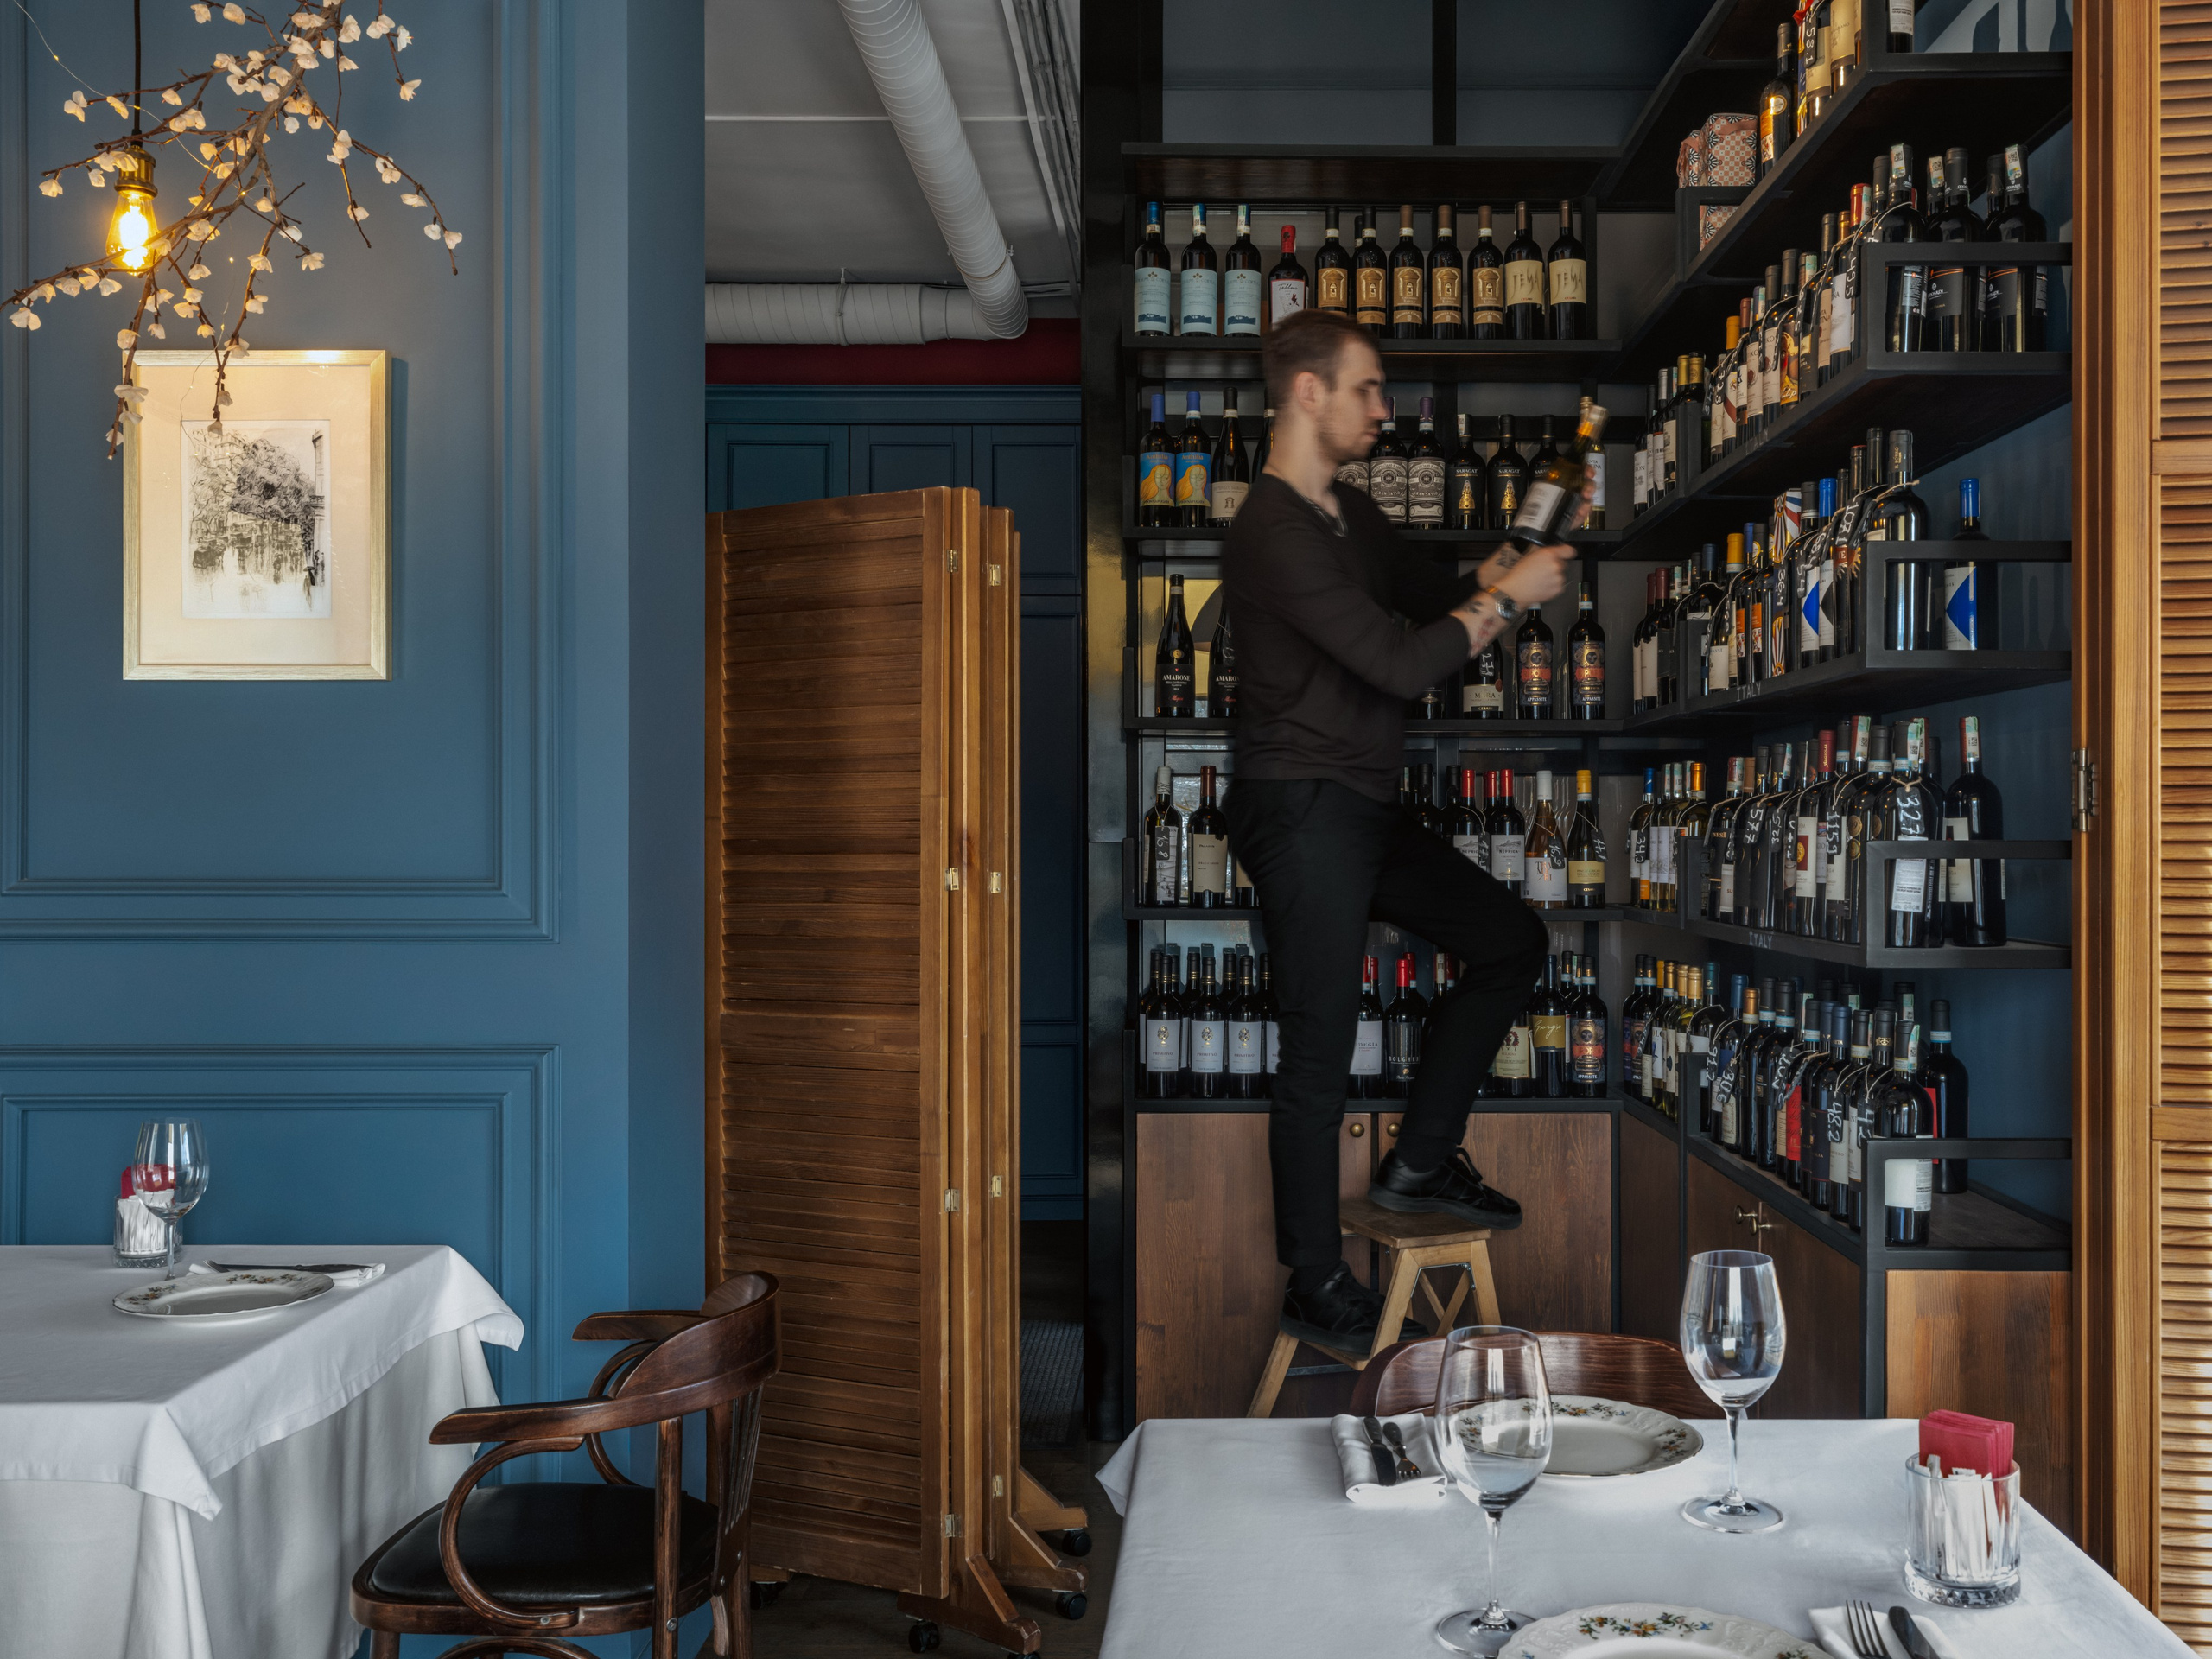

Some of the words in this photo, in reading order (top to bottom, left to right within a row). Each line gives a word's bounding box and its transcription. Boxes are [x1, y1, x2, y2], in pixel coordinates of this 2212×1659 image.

[1805, 27, 1815, 65] 58.1
[1845, 256, 1857, 296] 49.5
[1777, 569, 1786, 606] 36.4
[1736, 683, 1761, 702] ITALY
[1745, 809, 1764, 843] 57.7
[1897, 793, 1922, 836] 32.7
[1827, 1101, 1842, 1141] 48.2
